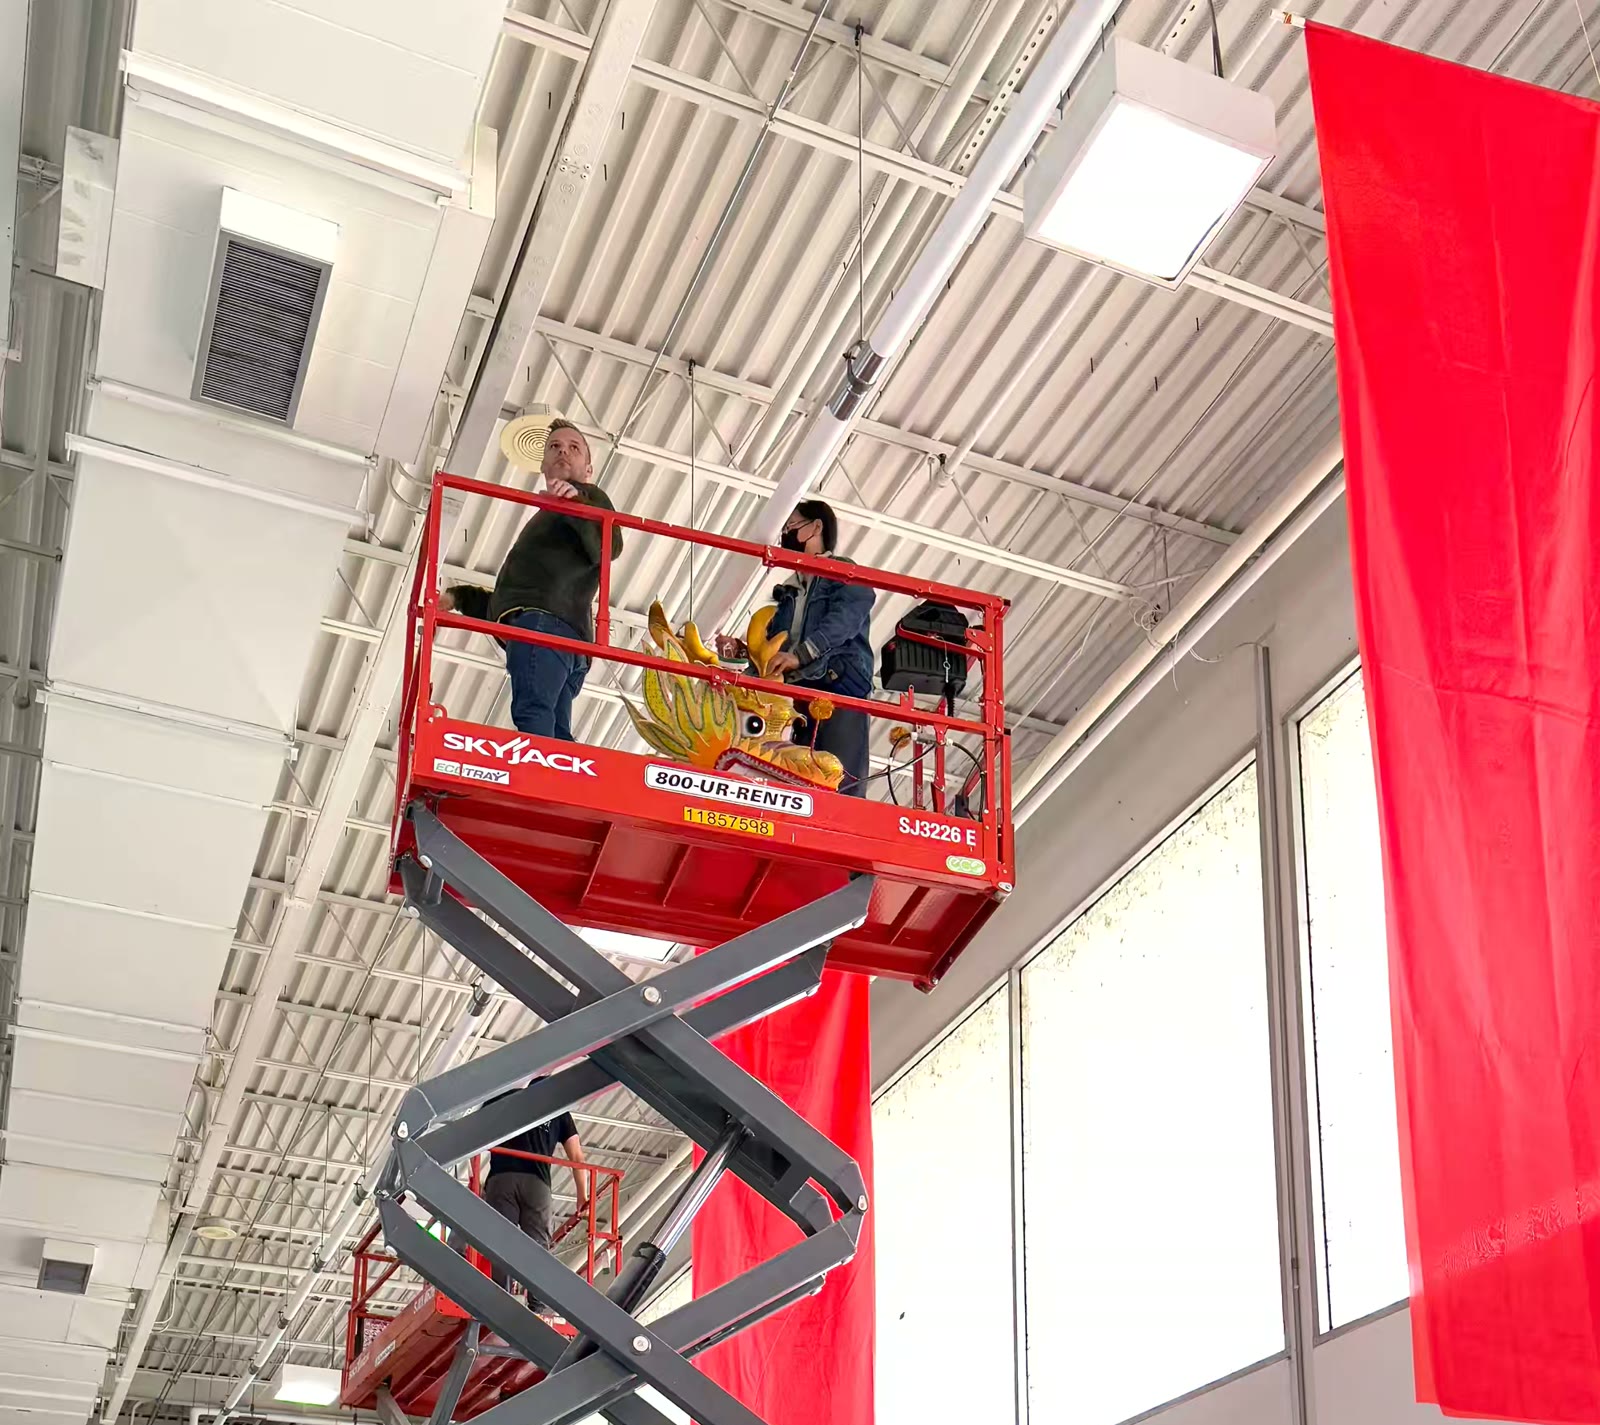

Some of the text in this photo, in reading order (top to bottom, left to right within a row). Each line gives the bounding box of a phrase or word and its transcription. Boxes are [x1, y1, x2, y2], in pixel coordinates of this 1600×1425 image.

[443, 732, 598, 777] SKYJACK
[655, 771, 804, 811] 800-UR-RENTS
[686, 808, 769, 835] 11857598
[898, 816, 976, 847] SJ3226 E
